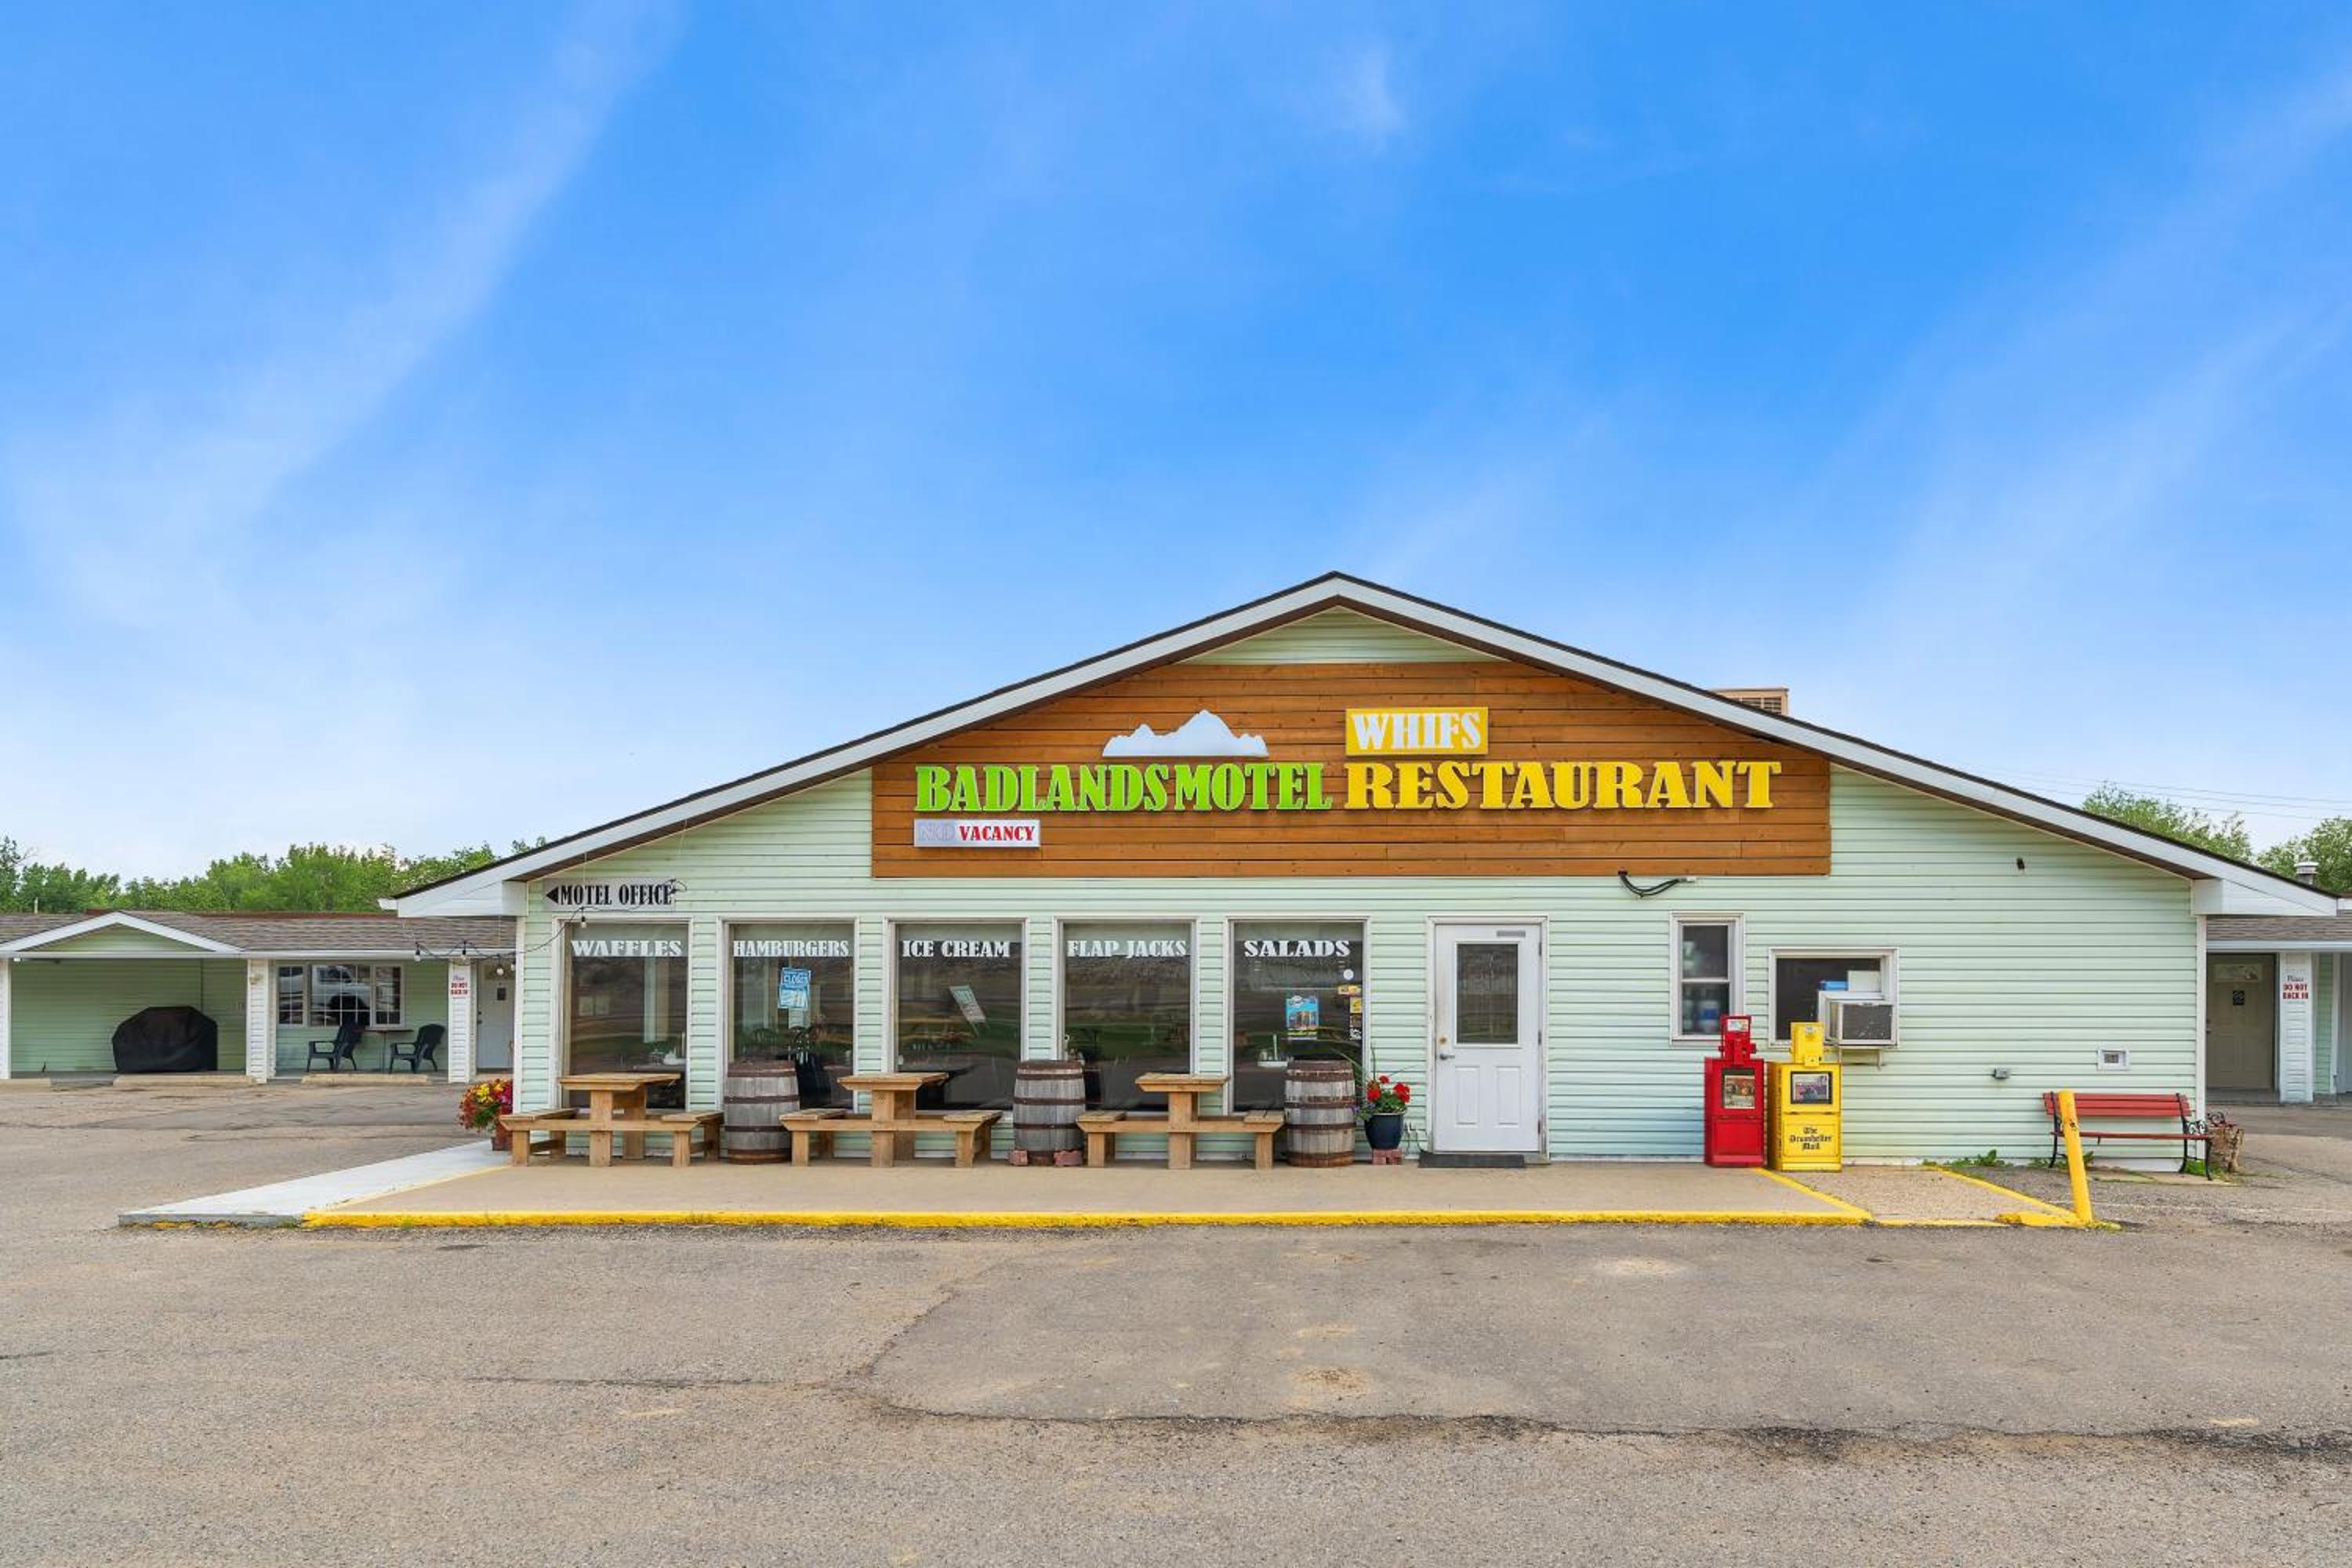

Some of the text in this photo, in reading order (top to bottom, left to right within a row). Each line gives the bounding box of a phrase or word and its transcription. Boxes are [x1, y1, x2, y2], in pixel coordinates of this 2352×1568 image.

[1351, 713, 1482, 750] WHIFS
[914, 762, 1332, 812] BADLANDS MOTEL
[1344, 760, 1782, 809] RESTAURANT
[959, 826, 1035, 841] VACANCY
[561, 884, 672, 906] MOTEL OFFICE
[571, 940, 683, 957] WAFFLES
[733, 940, 849, 957] HAMBURGERS
[902, 940, 1010, 957] ICE CREAM
[1067, 940, 1186, 958] FLAP JACKS
[1244, 940, 1350, 957] SALADS
